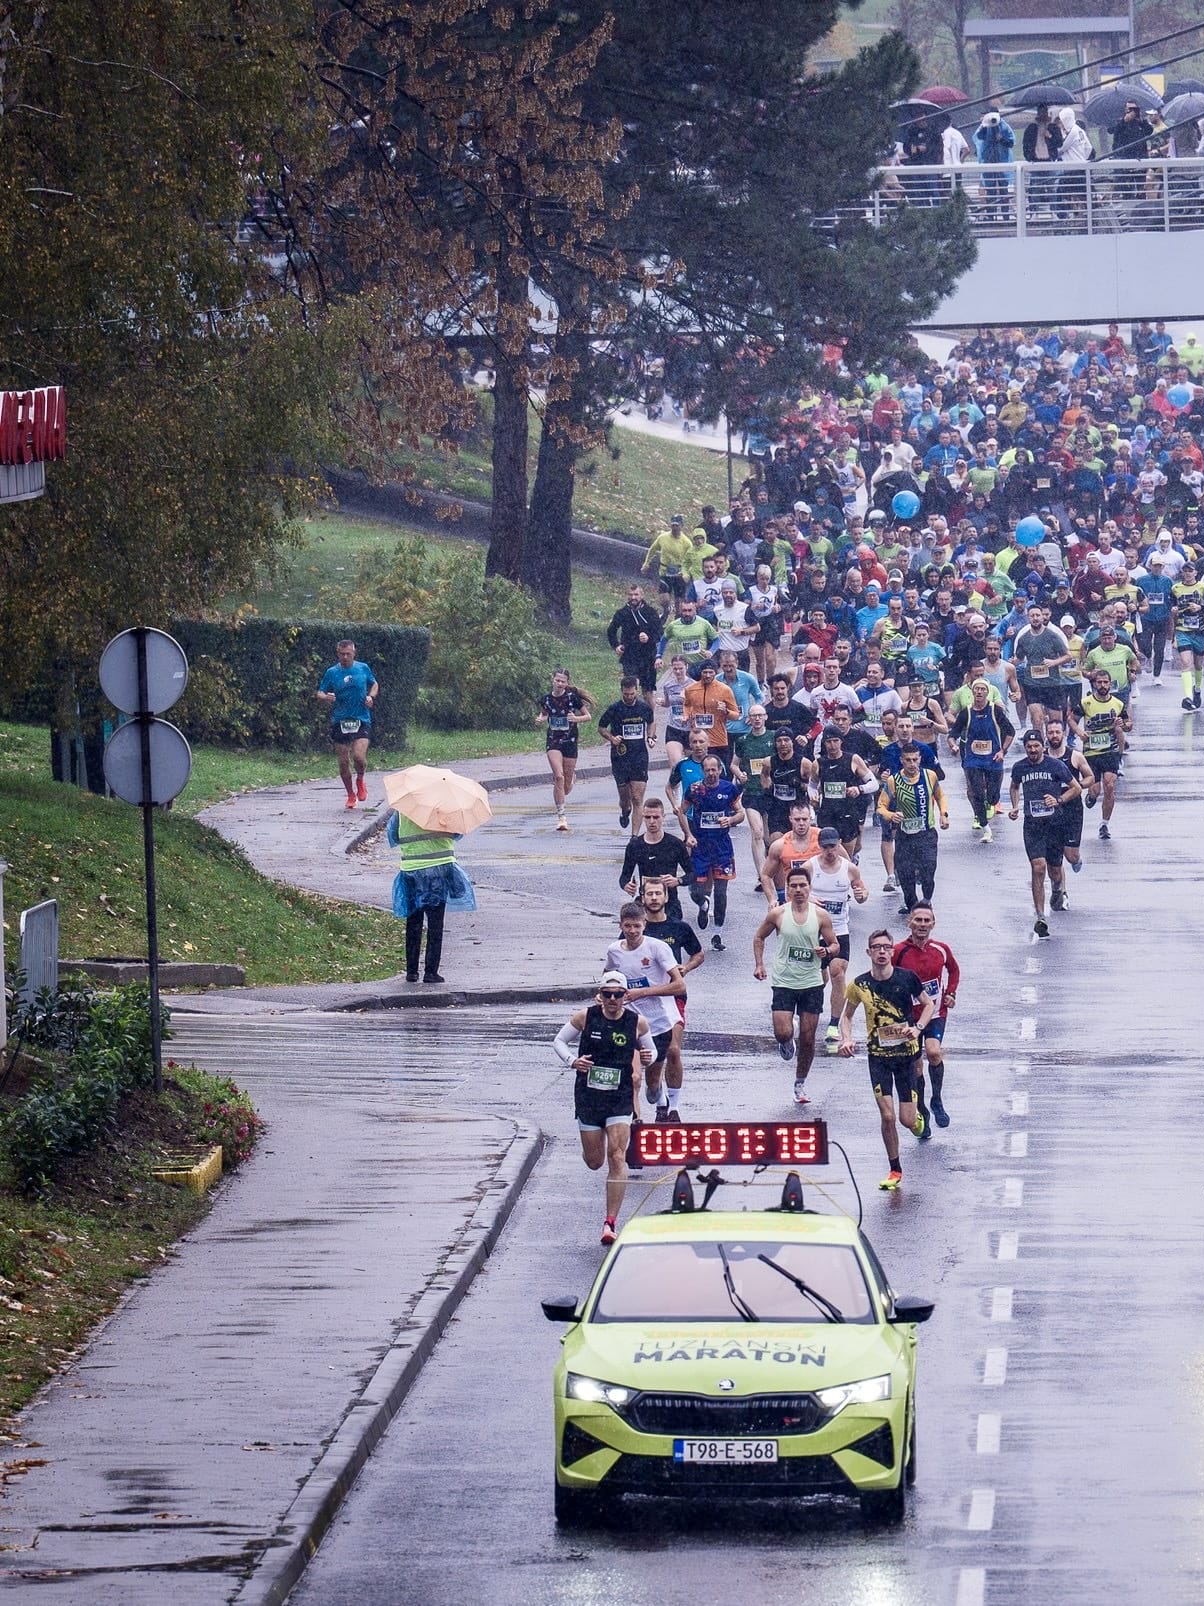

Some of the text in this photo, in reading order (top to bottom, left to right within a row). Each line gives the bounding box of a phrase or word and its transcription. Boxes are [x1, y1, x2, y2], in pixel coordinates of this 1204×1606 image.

[1021, 772, 1053, 784] BANGKOK
[640, 1127, 816, 1160] 00:01:18
[634, 1339, 826, 1354] TUZLANSKI
[633, 1348, 826, 1367] MARATON
[686, 1442, 774, 1459] T98-E-568
